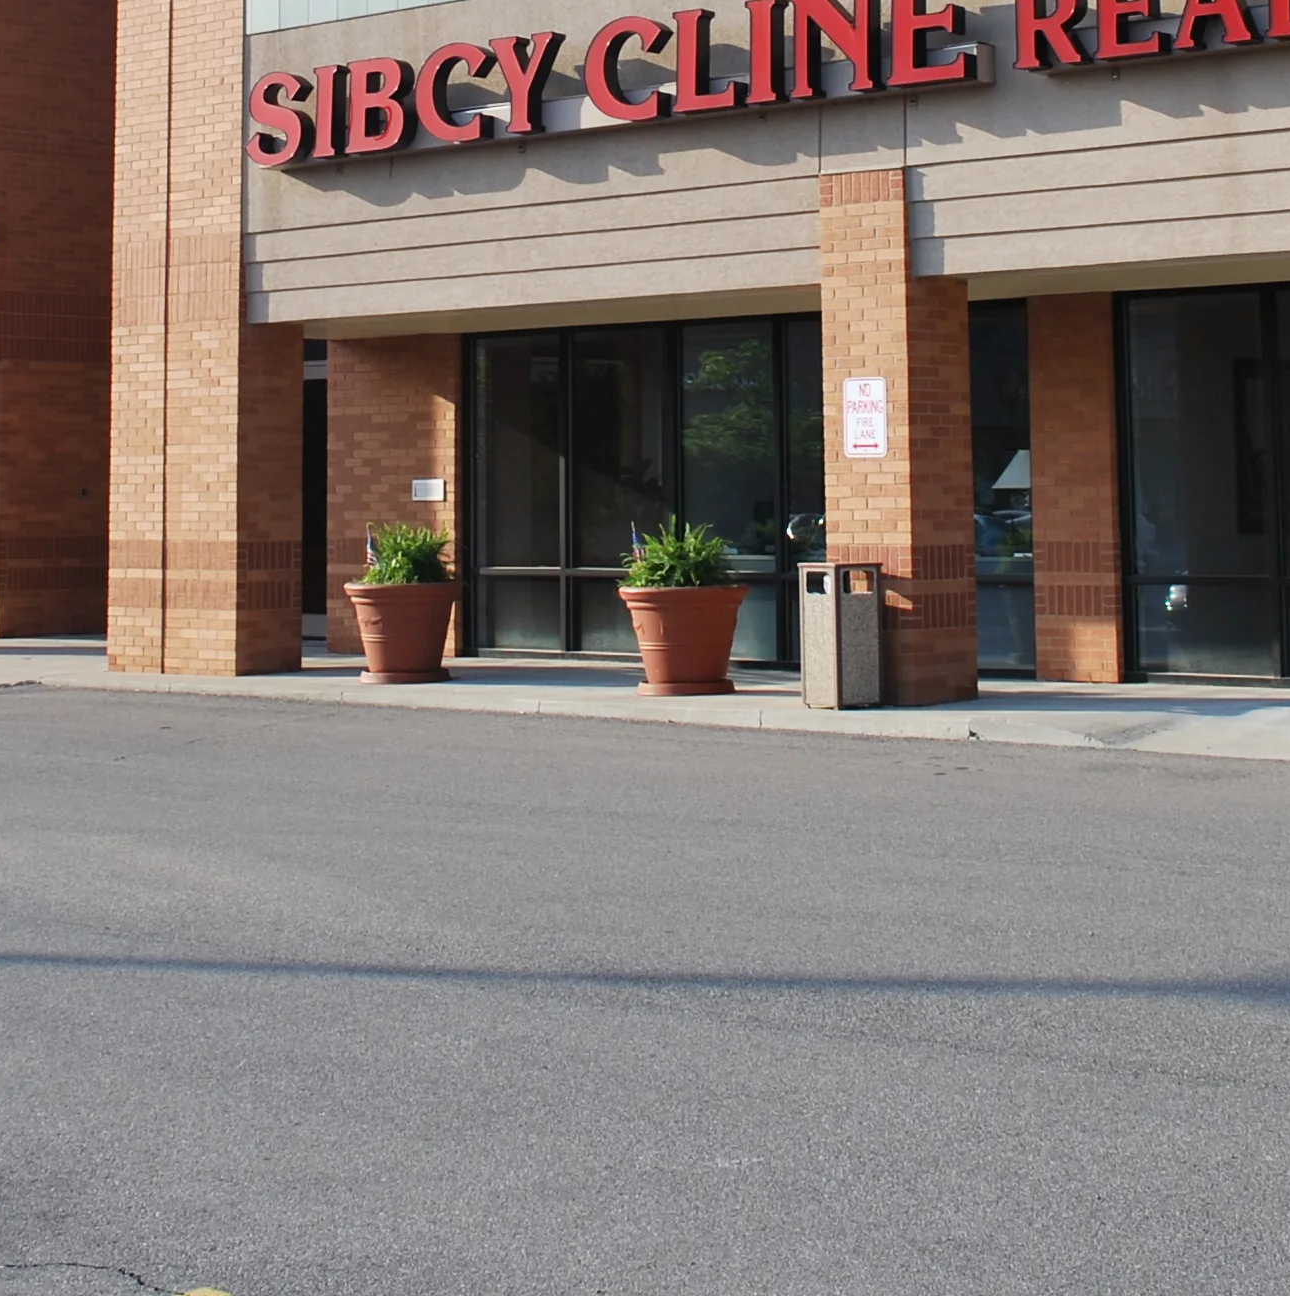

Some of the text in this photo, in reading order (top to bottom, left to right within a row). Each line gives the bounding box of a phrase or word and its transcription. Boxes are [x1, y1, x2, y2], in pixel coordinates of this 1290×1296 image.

[246, 30, 566, 168] SIBCY
[859, 383, 871, 397] NO
[847, 399, 884, 414] PARKING
[856, 417, 874, 427] FIRE
[855, 429, 877, 440] LANE
